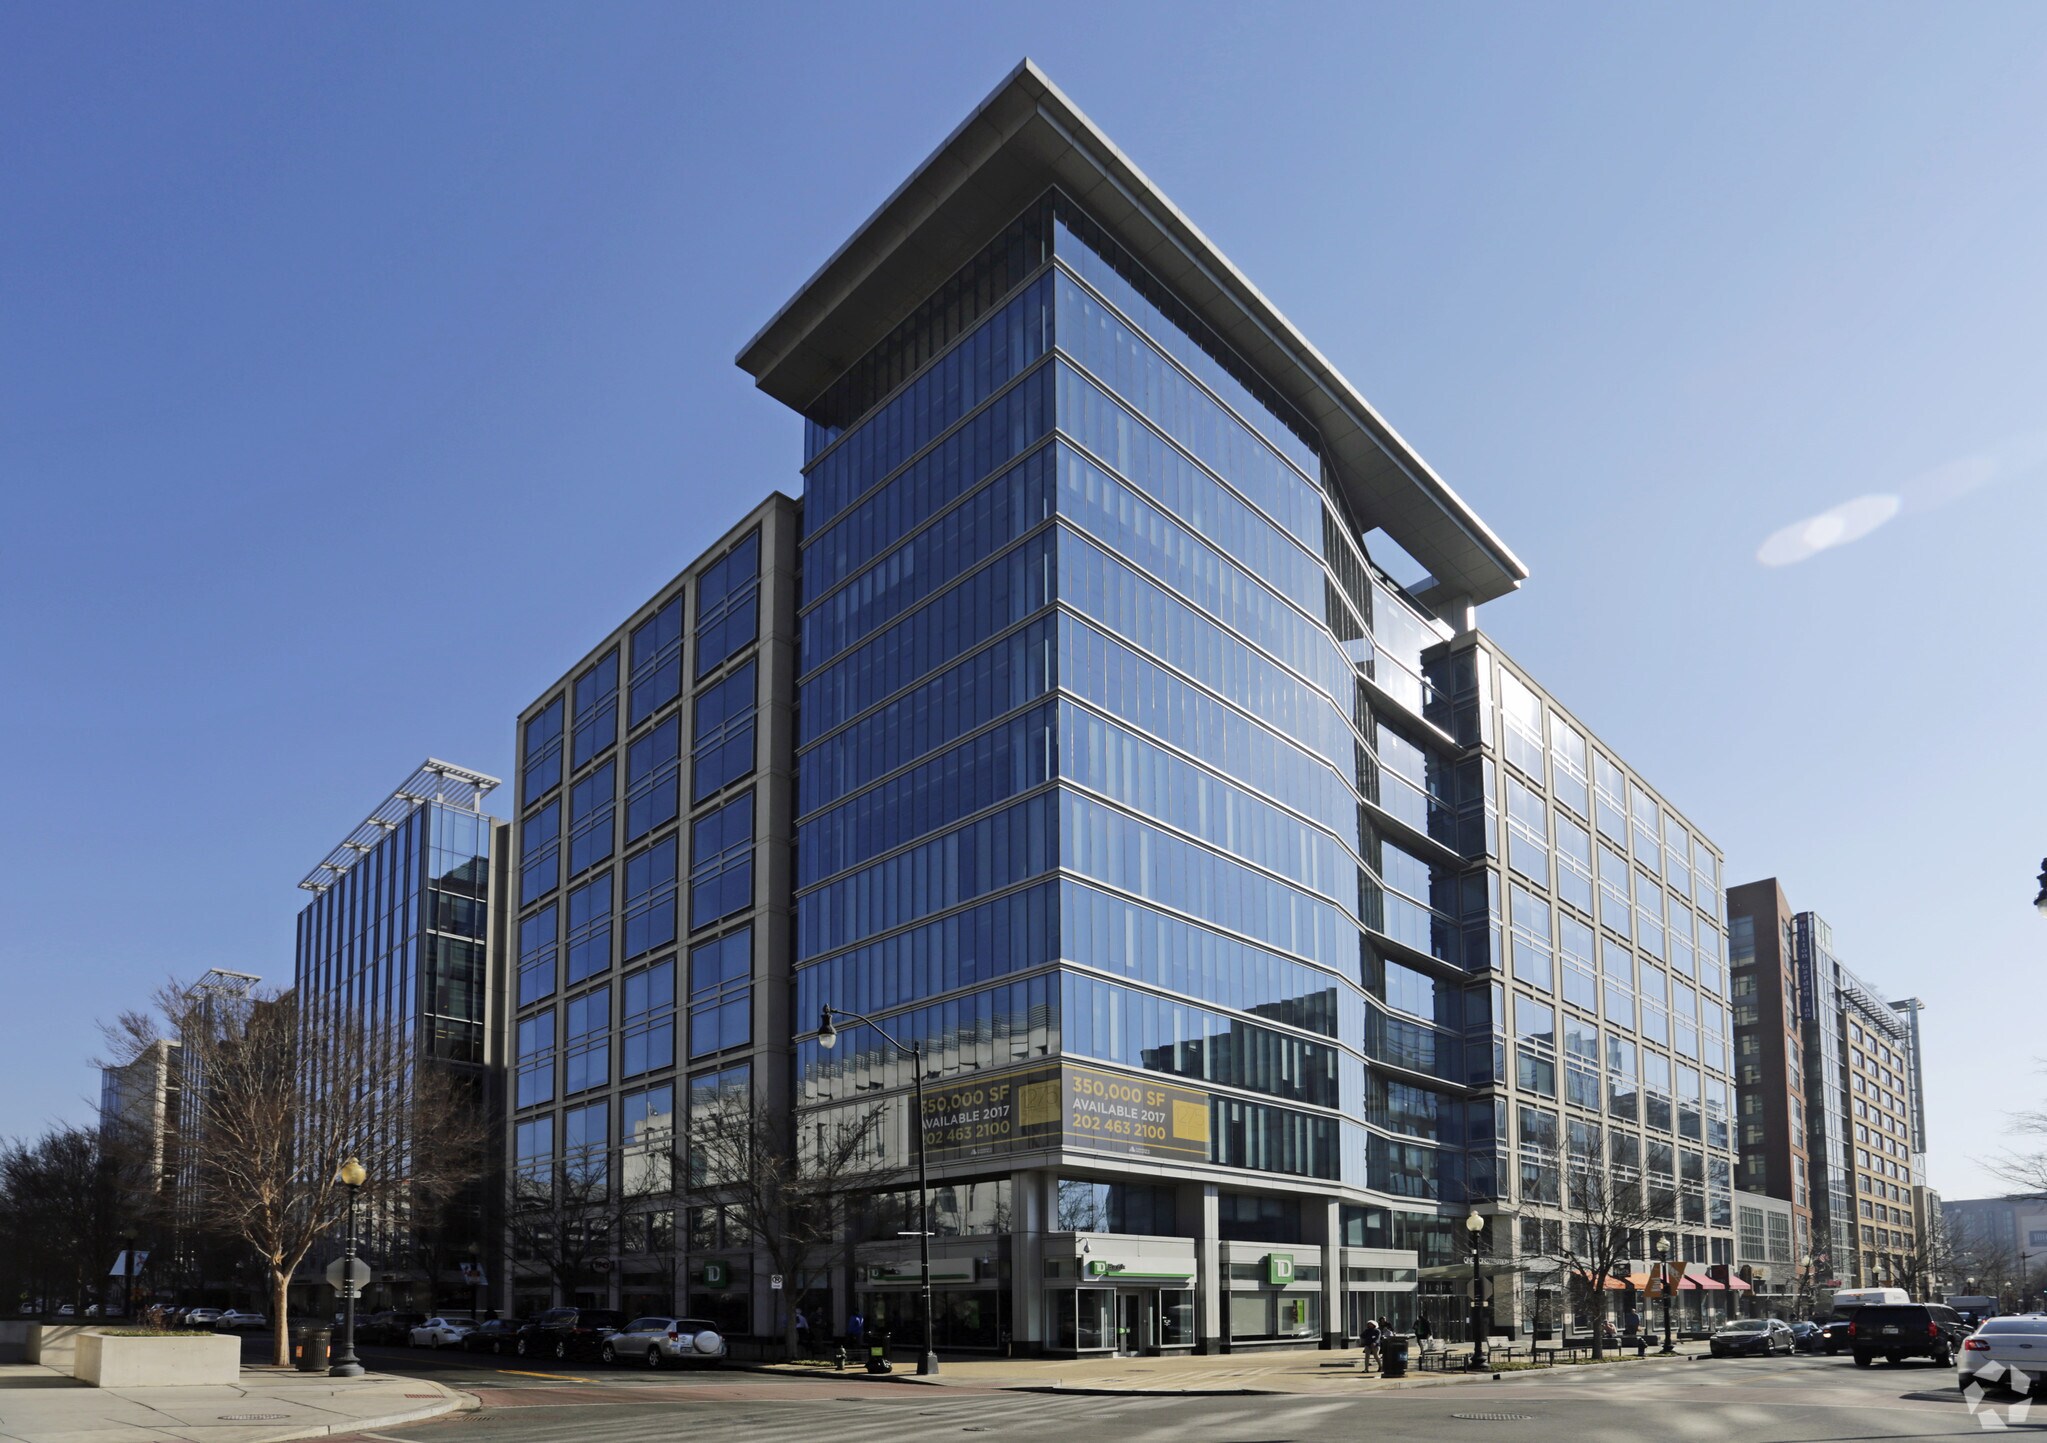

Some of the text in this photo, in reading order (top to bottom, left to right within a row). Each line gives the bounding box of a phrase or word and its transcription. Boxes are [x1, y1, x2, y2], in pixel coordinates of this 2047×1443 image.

[989, 1084, 1010, 1102] SF
[1072, 1076, 1166, 1107] 350,000 SF
[982, 1105, 1010, 1120] 2017
[1072, 1098, 1166, 1123] AVAILABLE 2017
[923, 1120, 1010, 1146] 02 463 2100
[1072, 1114, 1166, 1140] 202 463 2100
[705, 1265, 721, 1282] TD
[1095, 1262, 1106, 1272] TD
[1273, 1258, 1292, 1278] TD
